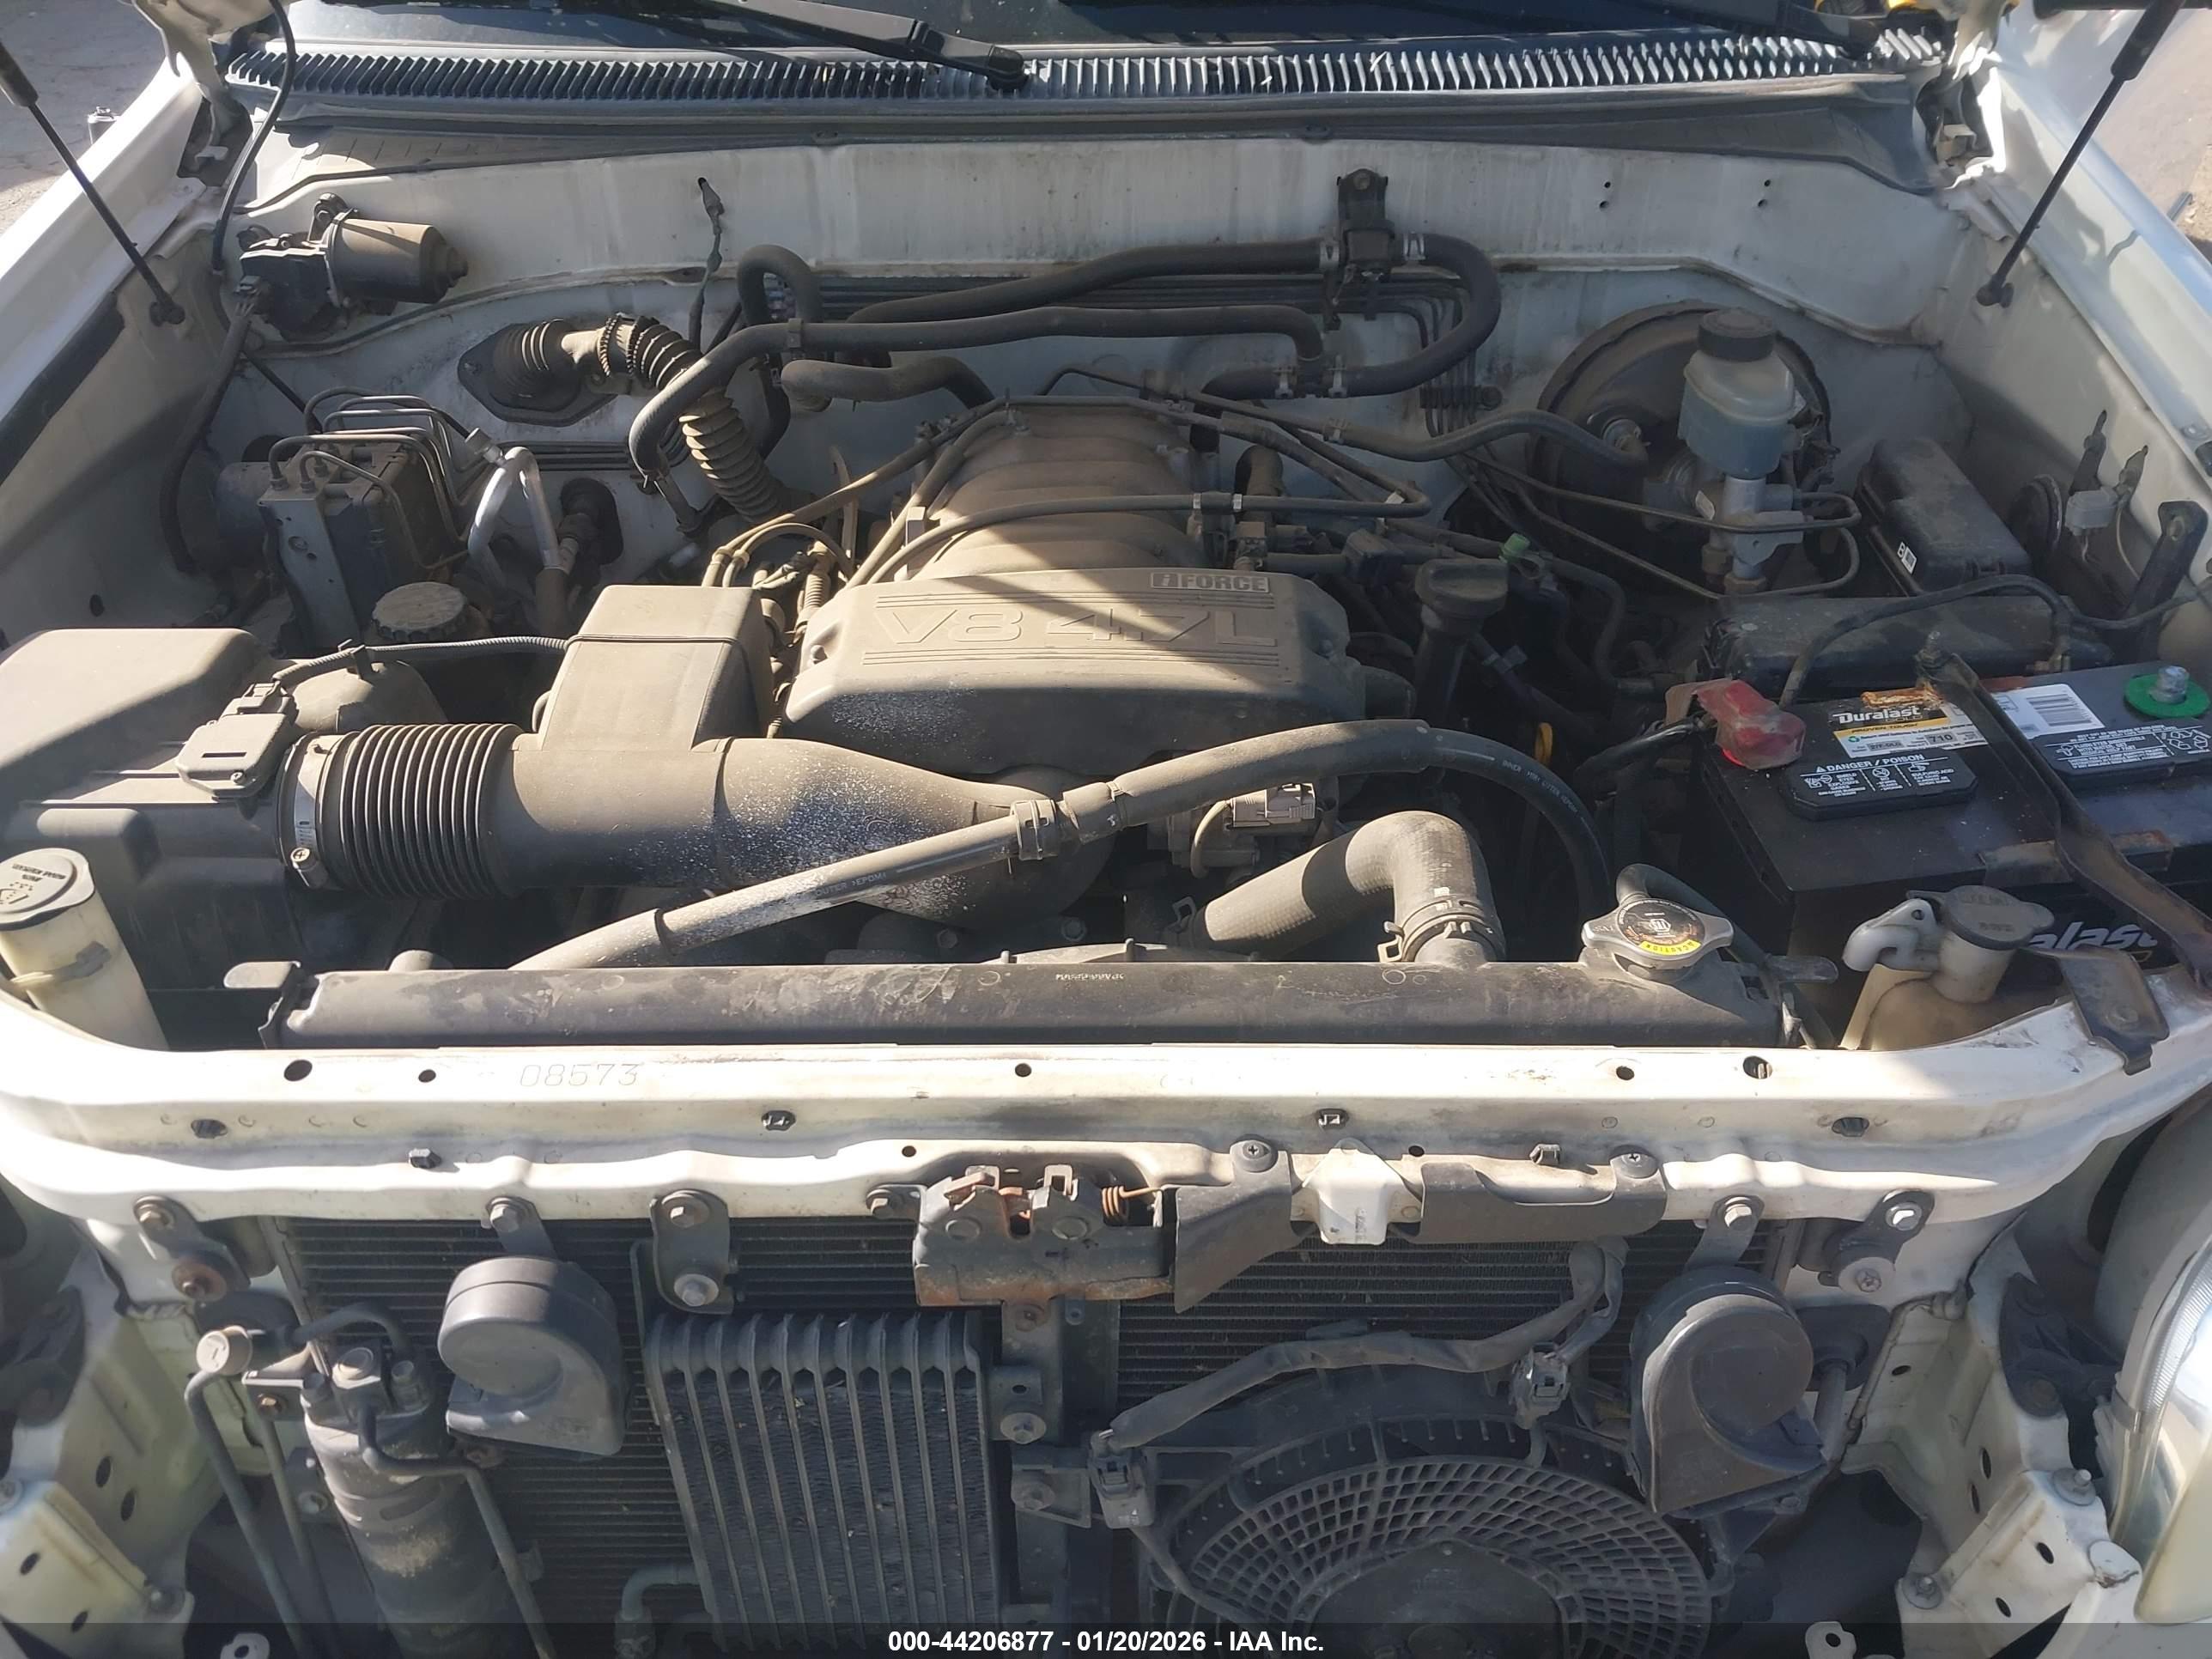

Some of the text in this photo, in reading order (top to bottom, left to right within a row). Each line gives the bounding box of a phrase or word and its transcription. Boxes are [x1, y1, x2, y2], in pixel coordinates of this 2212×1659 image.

[874, 608, 1278, 647] V8 4.7L
[1832, 705, 1922, 724] Duralast
[1929, 733, 1954, 743] 710
[1826, 761, 1872, 772] DANGER
[1881, 754, 1925, 764] POISON
[520, 1063, 640, 1087] 08573
